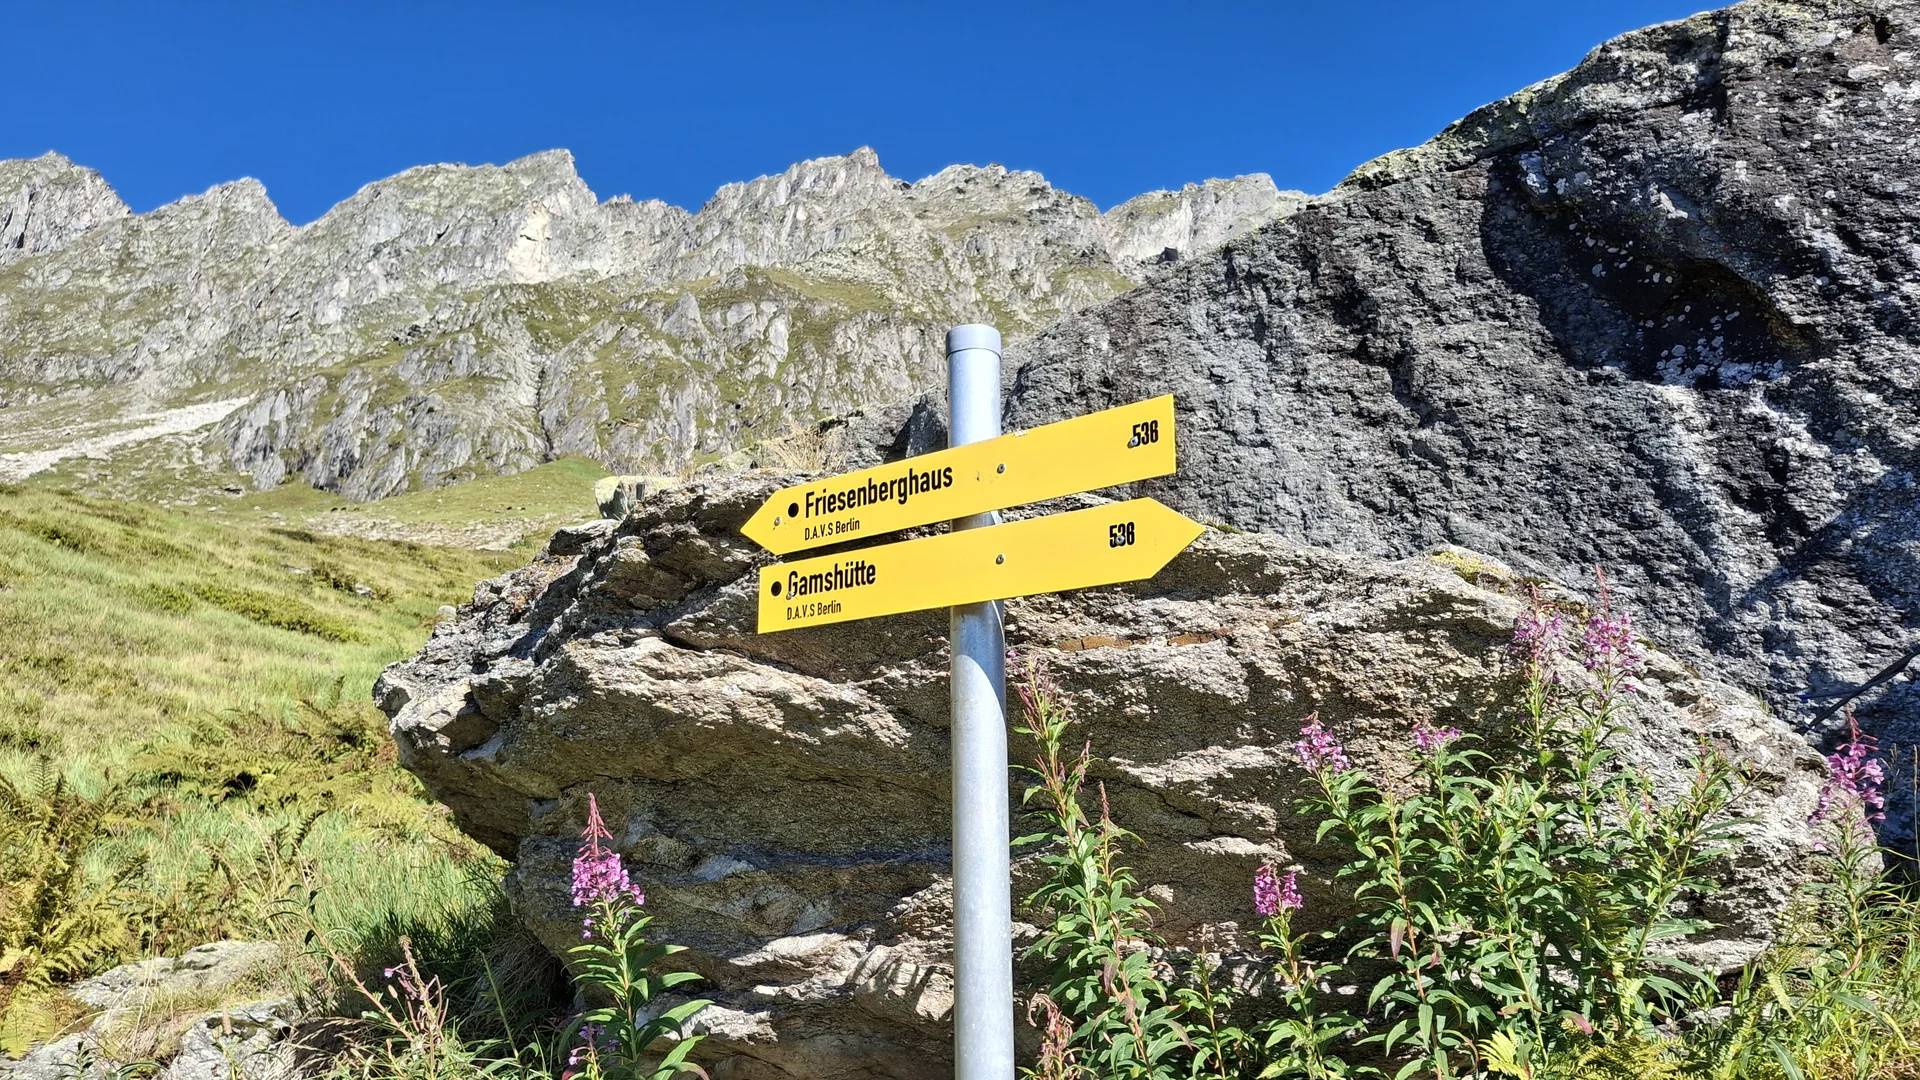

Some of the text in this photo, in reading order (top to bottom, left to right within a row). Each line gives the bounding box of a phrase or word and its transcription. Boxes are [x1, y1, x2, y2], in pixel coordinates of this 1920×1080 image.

[805, 466, 953, 518] Friesenberghaus
[804, 517, 860, 541] D.A.V.S Berlin
[788, 560, 876, 598] Gamshütte
[786, 600, 842, 621] D.A.V.S Berlin
